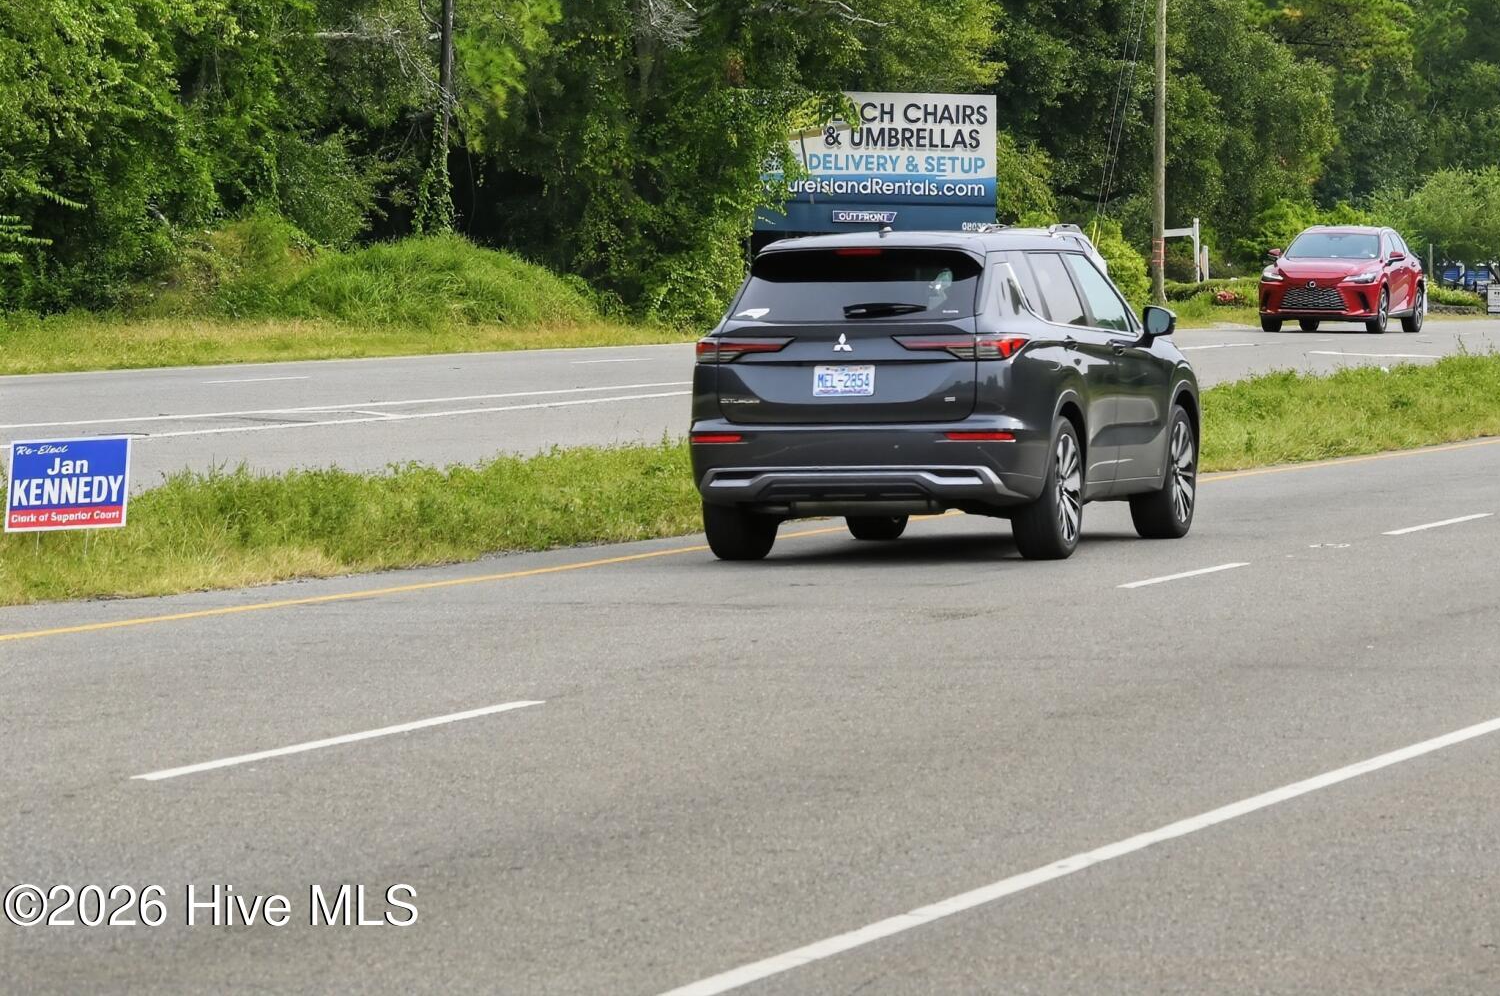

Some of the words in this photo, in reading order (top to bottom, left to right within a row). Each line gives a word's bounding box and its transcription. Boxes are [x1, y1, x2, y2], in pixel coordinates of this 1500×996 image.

[903, 103, 987, 125] CHAIRS
[825, 125, 841, 146] &
[851, 128, 981, 149] UMBRELLAS
[808, 153, 899, 173] DELIVERY
[905, 156, 919, 173] &
[924, 157, 986, 174] SETUP
[788, 178, 985, 196] ureislandRentals.com
[838, 212, 890, 222] OUTFRONT
[47, 457, 89, 475] Jan
[12, 475, 124, 507] KENNEDY
[51, 510, 92, 523] Superior
